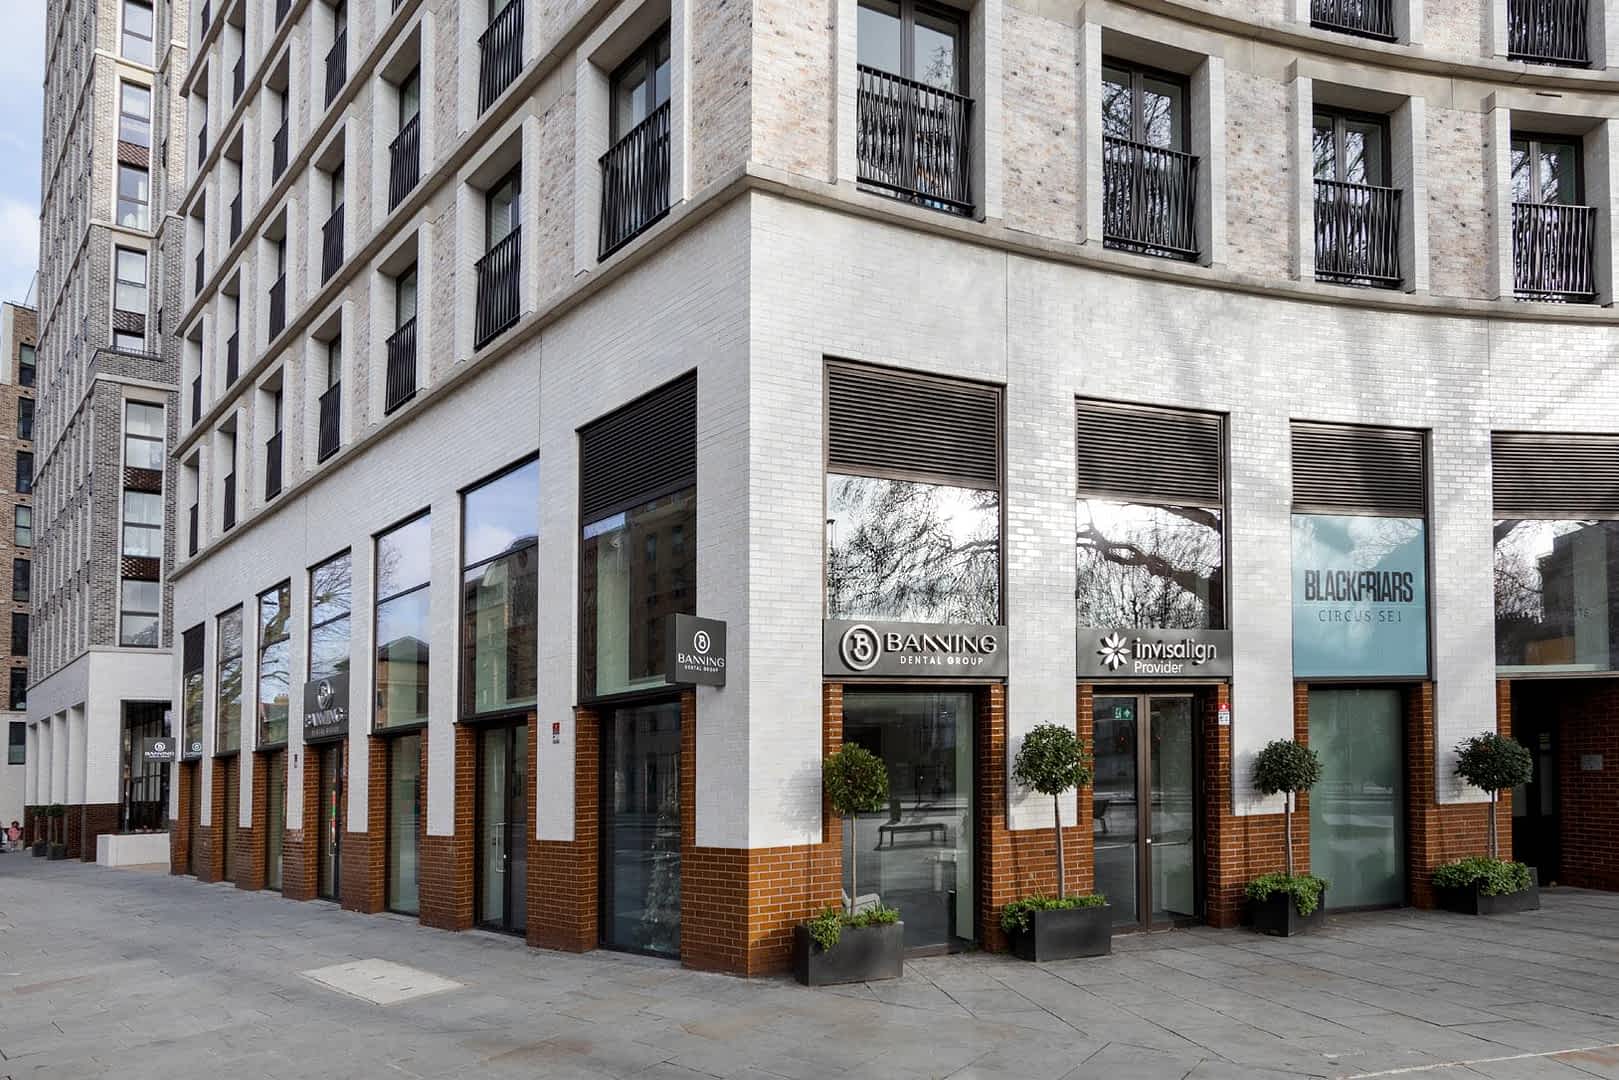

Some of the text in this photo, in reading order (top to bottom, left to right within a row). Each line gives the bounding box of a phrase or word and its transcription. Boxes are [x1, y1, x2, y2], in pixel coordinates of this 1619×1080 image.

[1304, 569, 1414, 603] BLACKFRIARS
[1318, 609, 1372, 623] CIRCUS
[886, 632, 998, 654] BANNING
[1135, 637, 1217, 665] invisalign
[678, 652, 725, 668] BANNING
[900, 655, 984, 666] DENTAL GROUP
[1134, 660, 1184, 674] Provider
